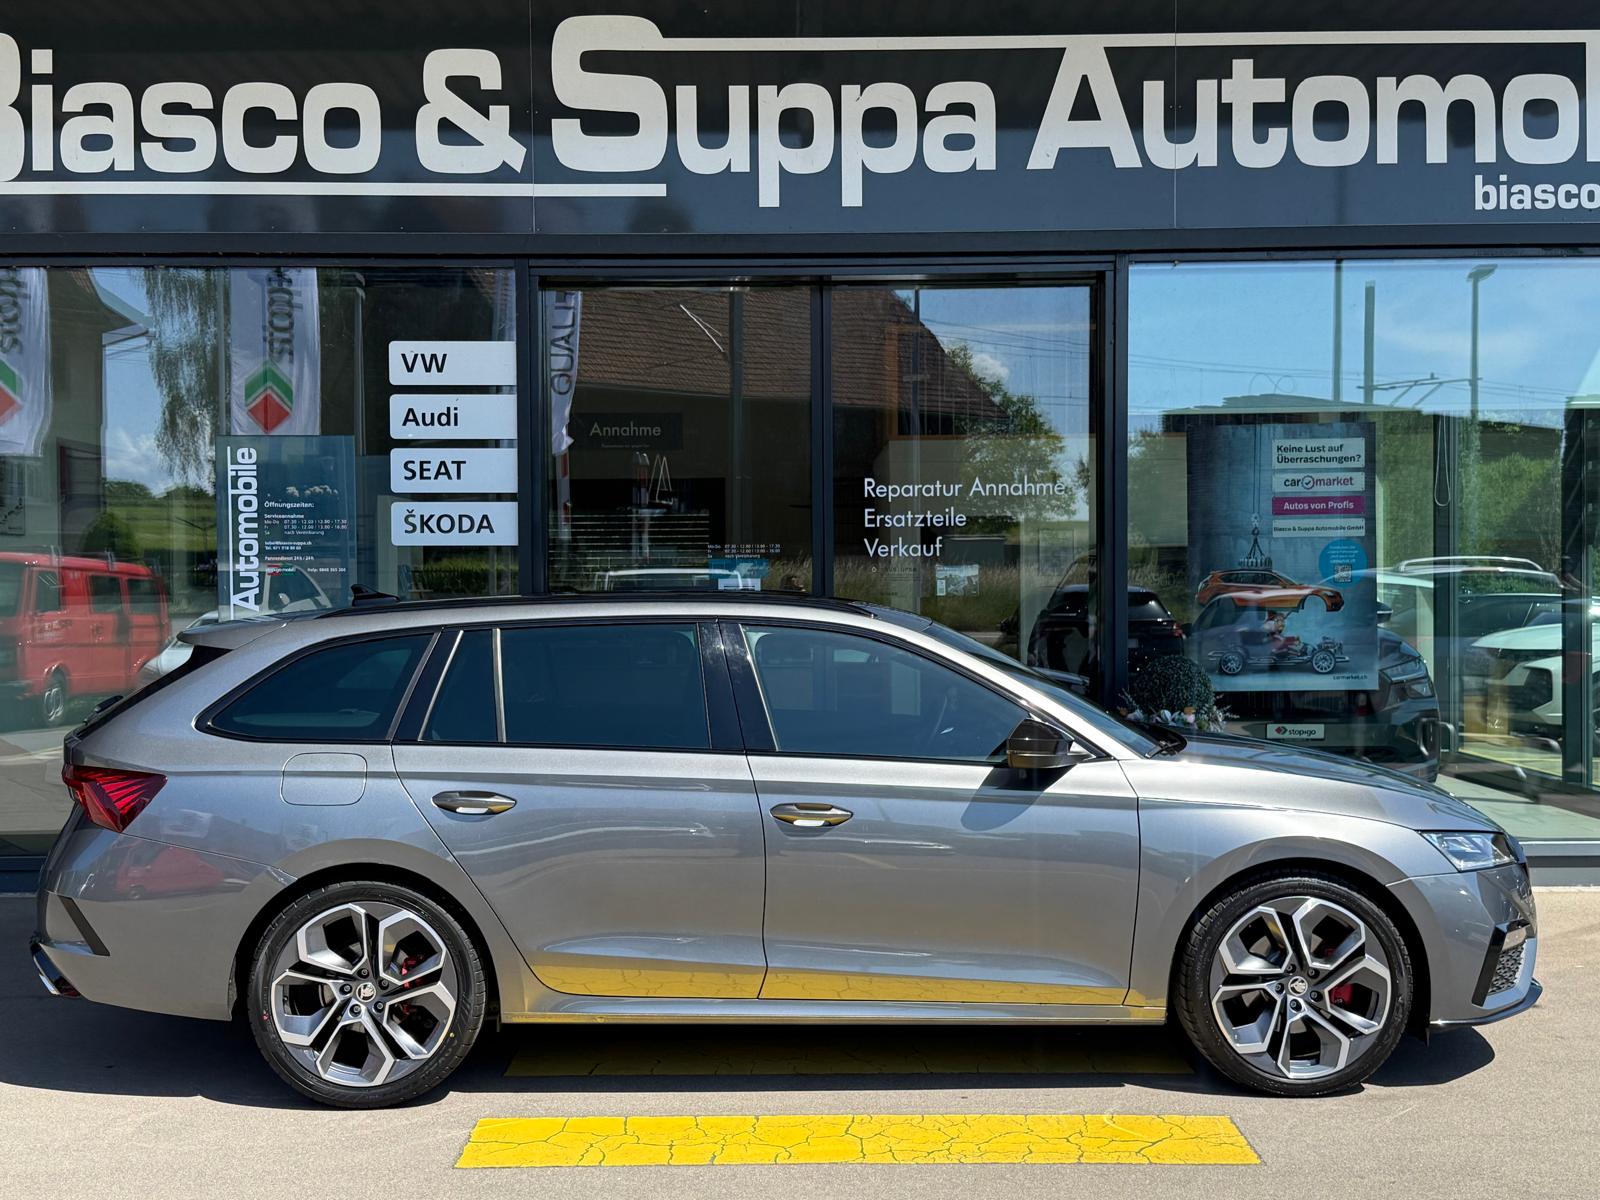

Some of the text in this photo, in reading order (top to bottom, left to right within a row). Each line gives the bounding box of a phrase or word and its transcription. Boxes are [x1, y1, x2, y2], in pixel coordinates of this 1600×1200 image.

[0, 15, 1600, 208] iasco & Suppa Automo
[1475, 174, 1600, 210] biasco
[400, 353, 448, 373] VW
[402, 406, 459, 427] Audi
[590, 421, 662, 437] Annahme
[1276, 444, 1344, 453] Keine Lust auf
[1276, 454, 1362, 464] Überraschungen?
[403, 460, 466, 480] SEAT
[864, 475, 1066, 502] Reparatur Annahme
[264, 500, 314, 509] Öffnungszeiten:
[1284, 502, 1308, 510] Autos
[1328, 501, 1354, 510] Profis
[404, 508, 495, 534] ŠKODA
[864, 506, 967, 528] Ersatzteile
[229, 447, 260, 612] Automobile
[864, 536, 943, 558] Verkauf
